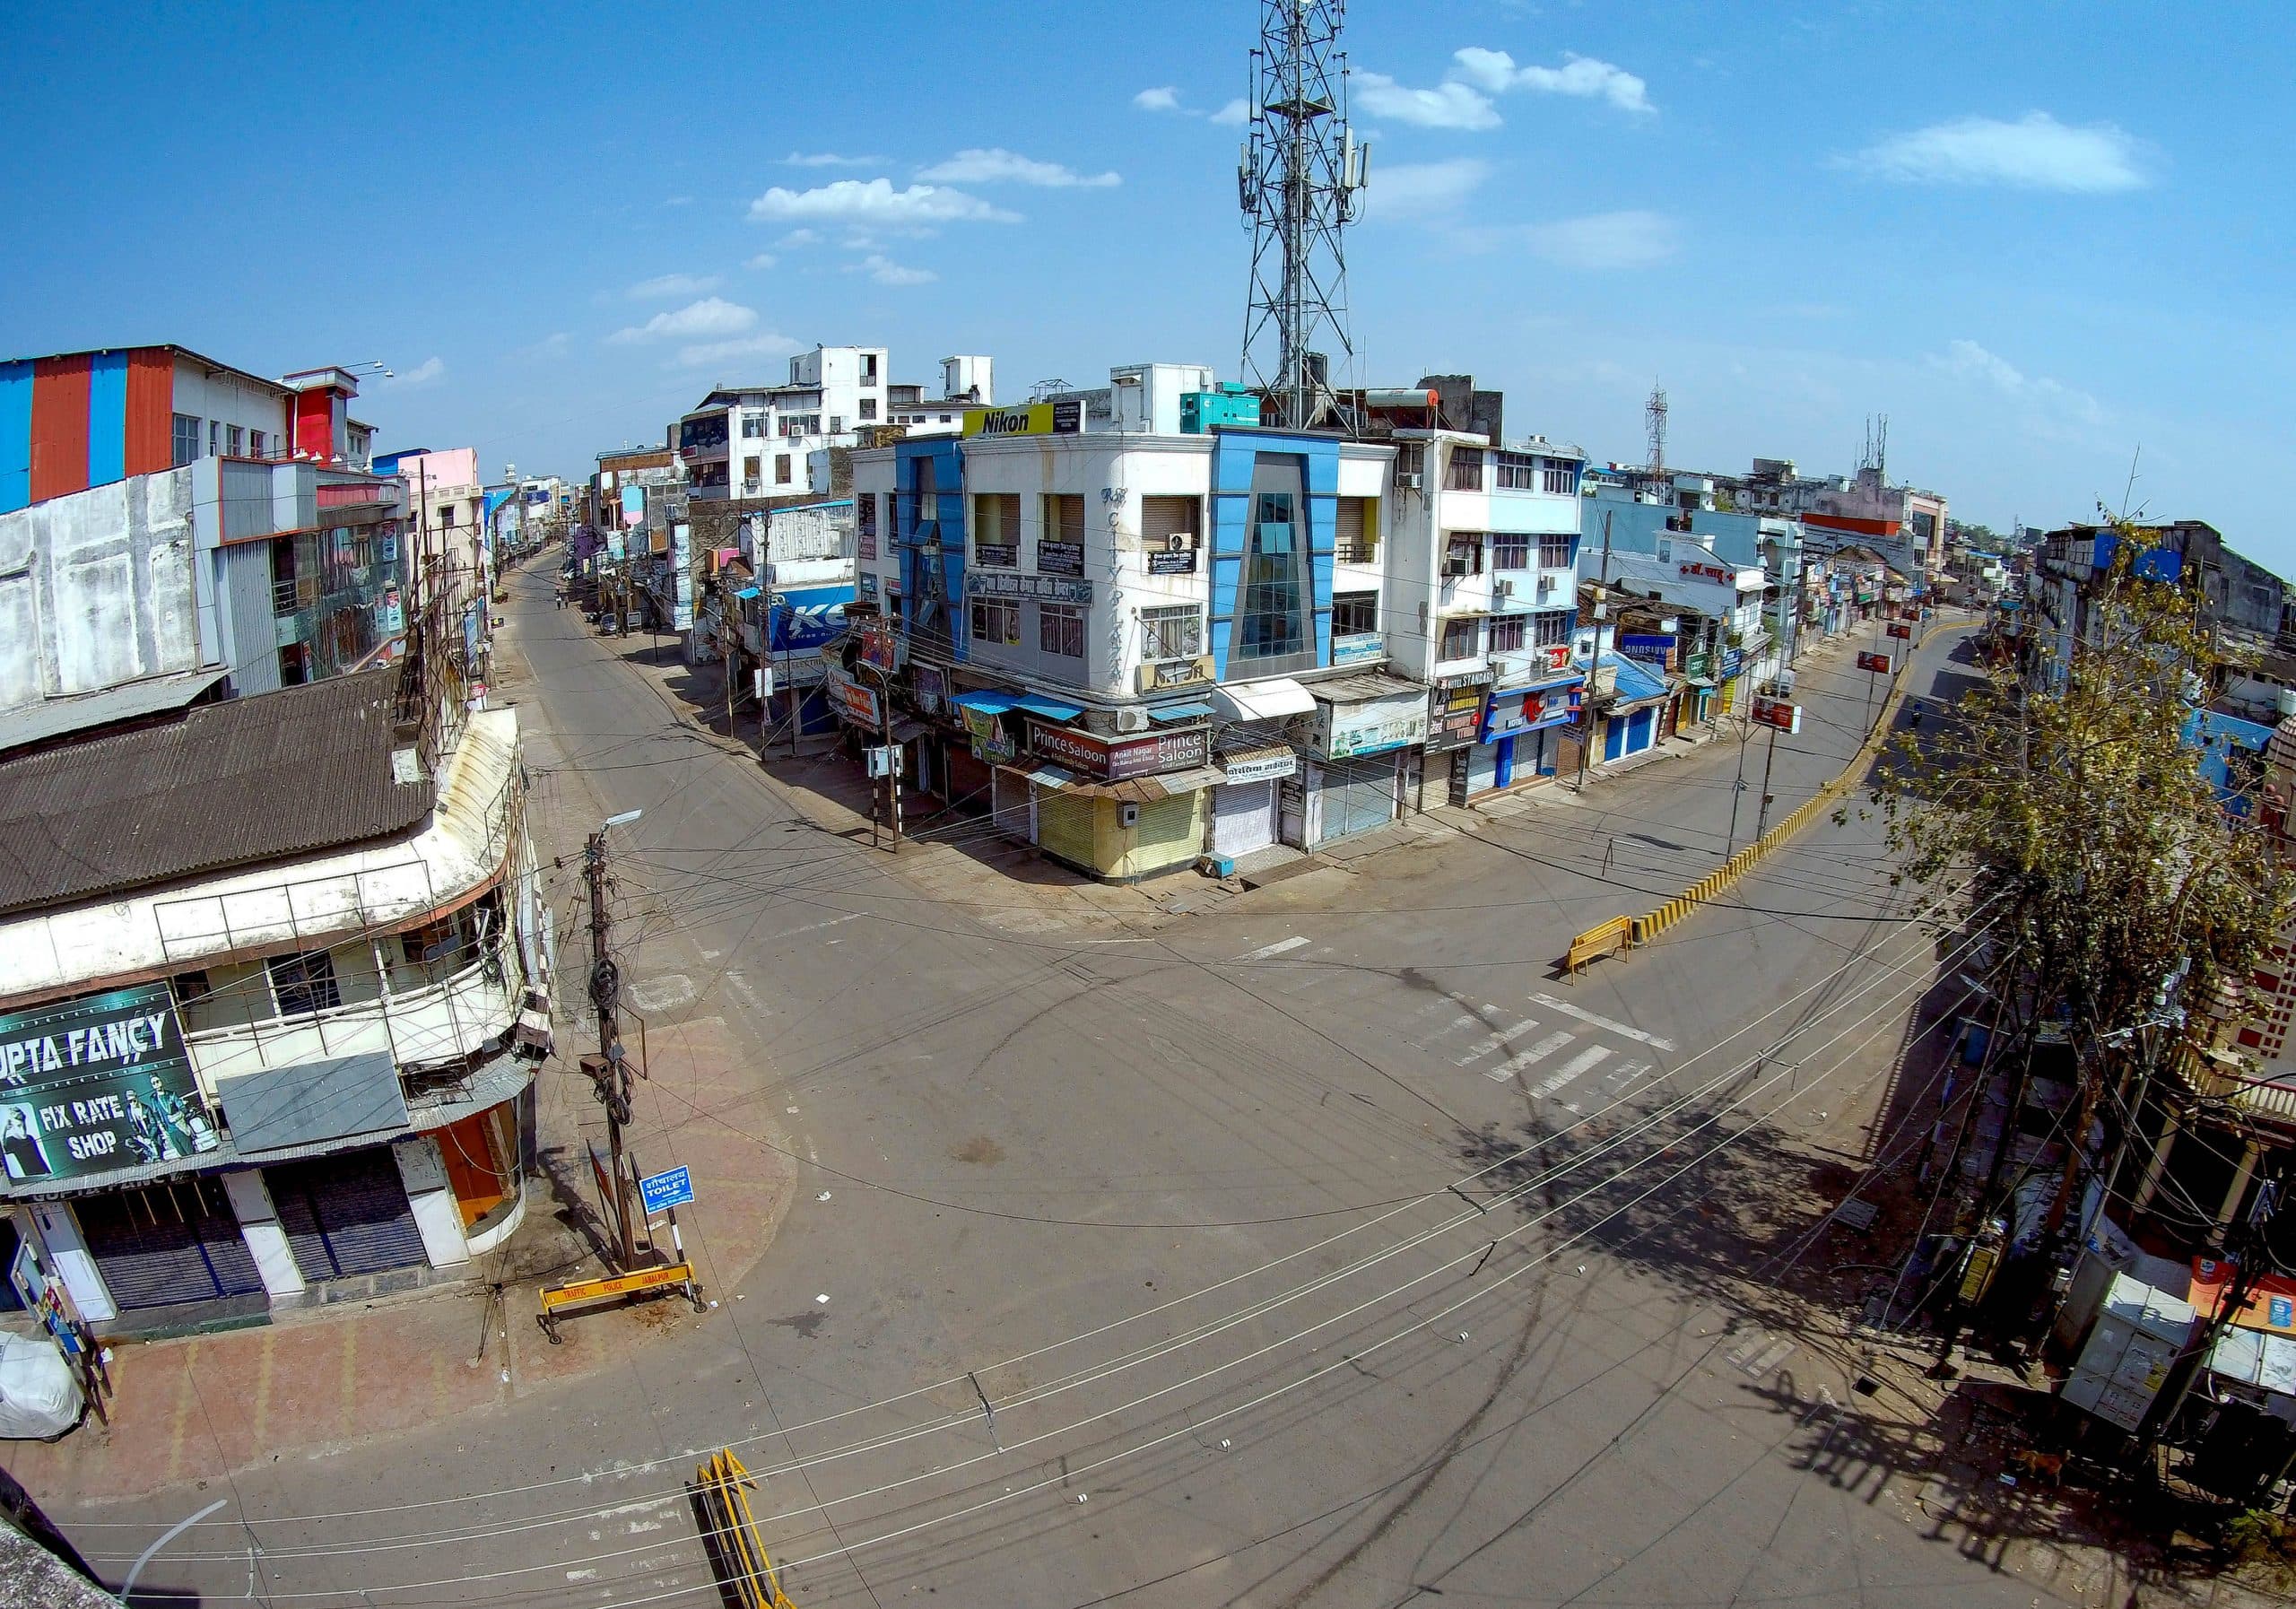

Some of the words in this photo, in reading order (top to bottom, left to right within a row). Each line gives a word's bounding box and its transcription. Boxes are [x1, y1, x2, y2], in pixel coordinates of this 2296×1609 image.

[982, 411, 1029, 433] Nikon
[1624, 645, 1666, 656] AMSUNG
[1462, 672, 1494, 688] STANDARD
[1033, 726, 1067, 752] Prince
[1068, 740, 1108, 765] Saloon
[1158, 733, 1202, 752] Prince
[1114, 749, 1133, 760] Ankit
[1133, 746, 1152, 758] Nagar
[1158, 746, 1203, 764] Saloon
[67, 1010, 168, 1066] FANCY
[39, 1104, 74, 1132] FIX
[73, 1094, 125, 1125] RATE
[67, 1130, 117, 1160] SHOP
[646, 1170, 686, 1189] शौचालय
[647, 1178, 687, 1197] TOILET
[563, 1288, 587, 1300] TRAFFIC
[603, 1281, 623, 1292] POLICE
[640, 1271, 670, 1285] JABALPUR
